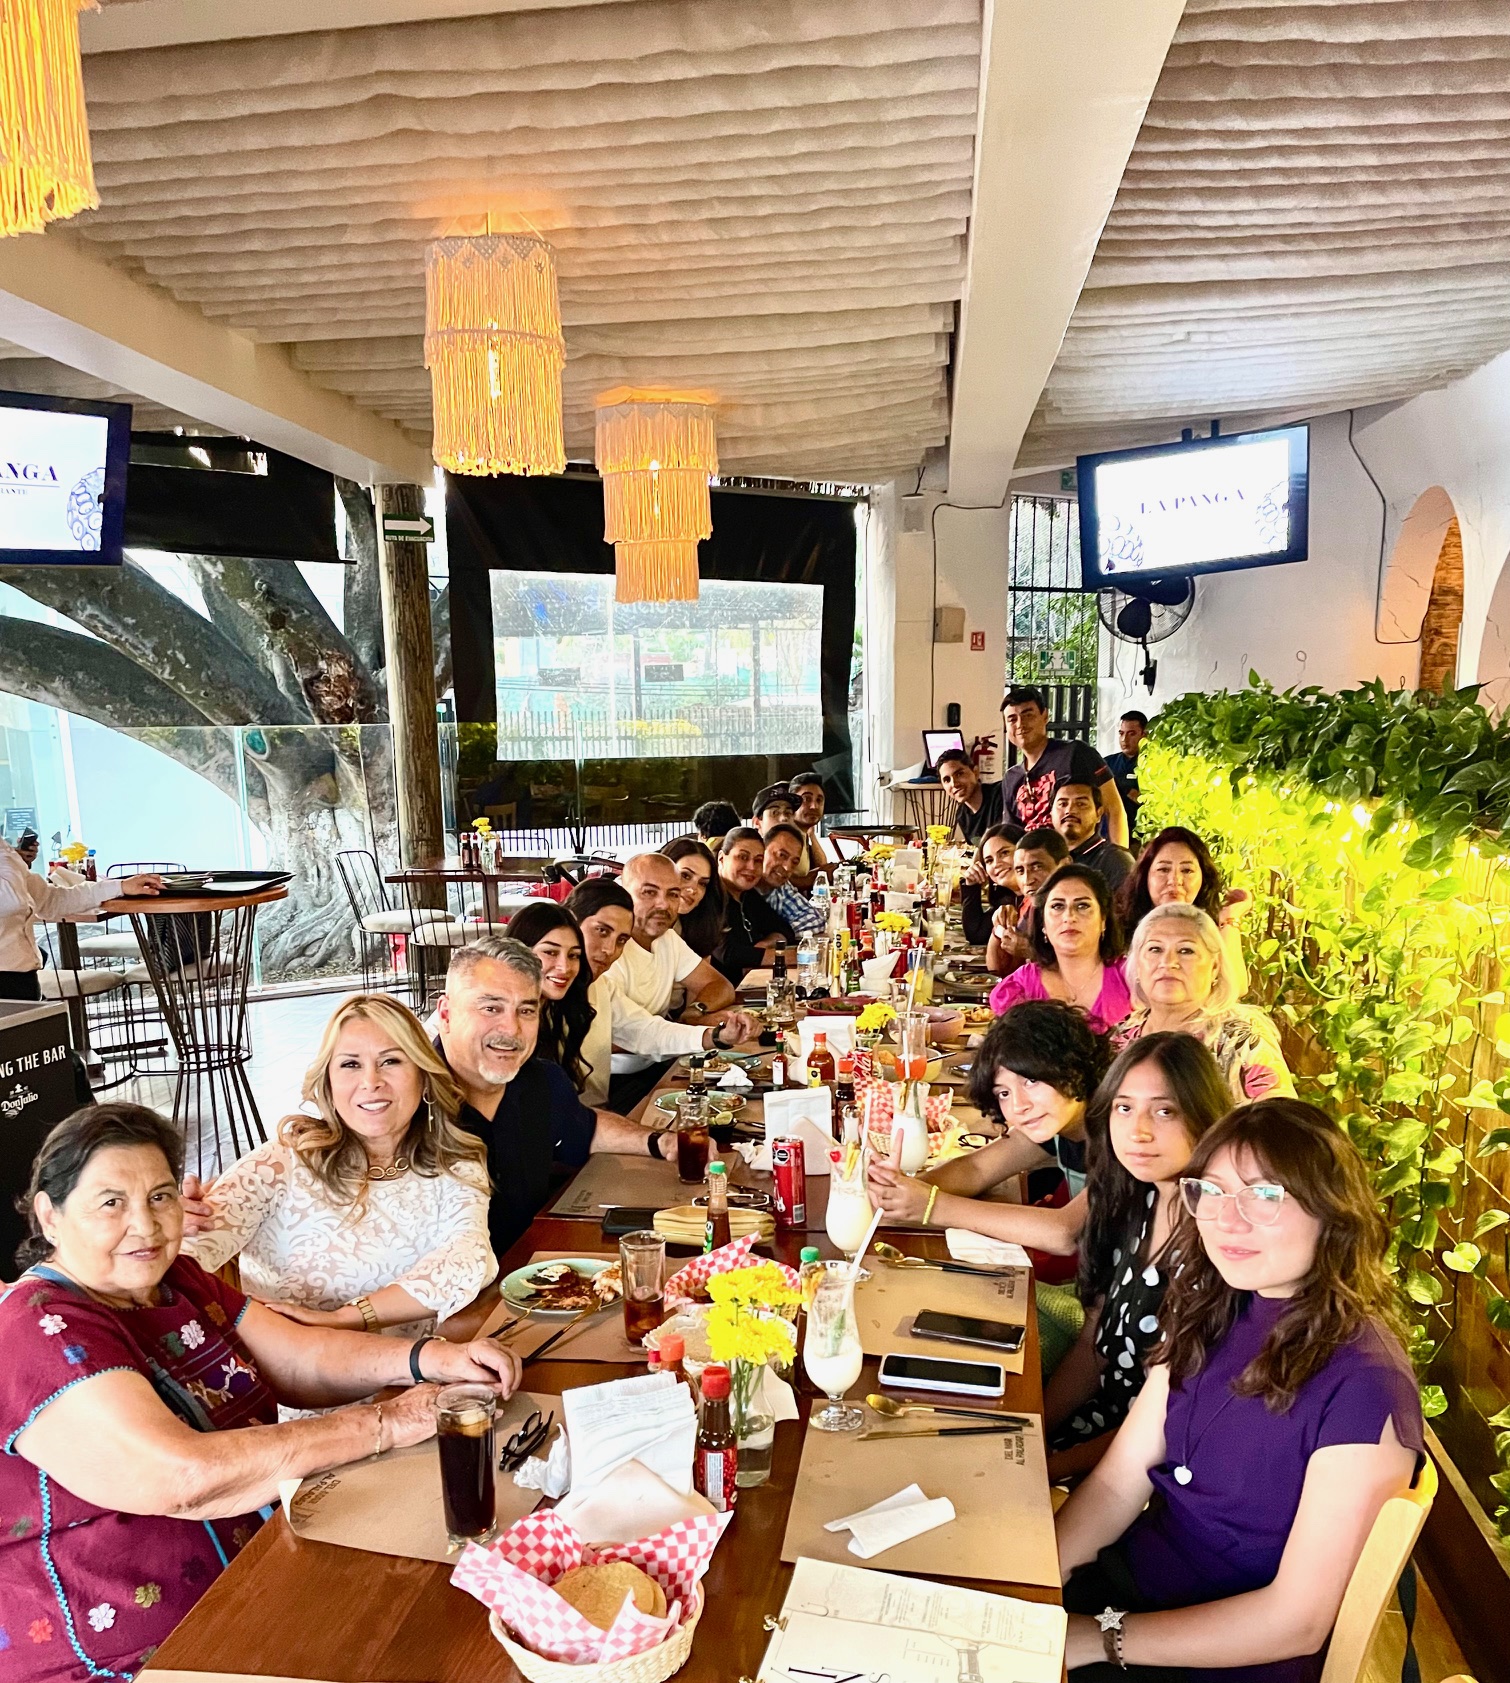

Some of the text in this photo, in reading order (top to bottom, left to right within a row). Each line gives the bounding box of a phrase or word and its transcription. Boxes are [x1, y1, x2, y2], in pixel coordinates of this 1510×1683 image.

[0, 462, 58, 481] NGA
[15, 1052, 40, 1073] THE
[42, 1044, 67, 1065] BAR
